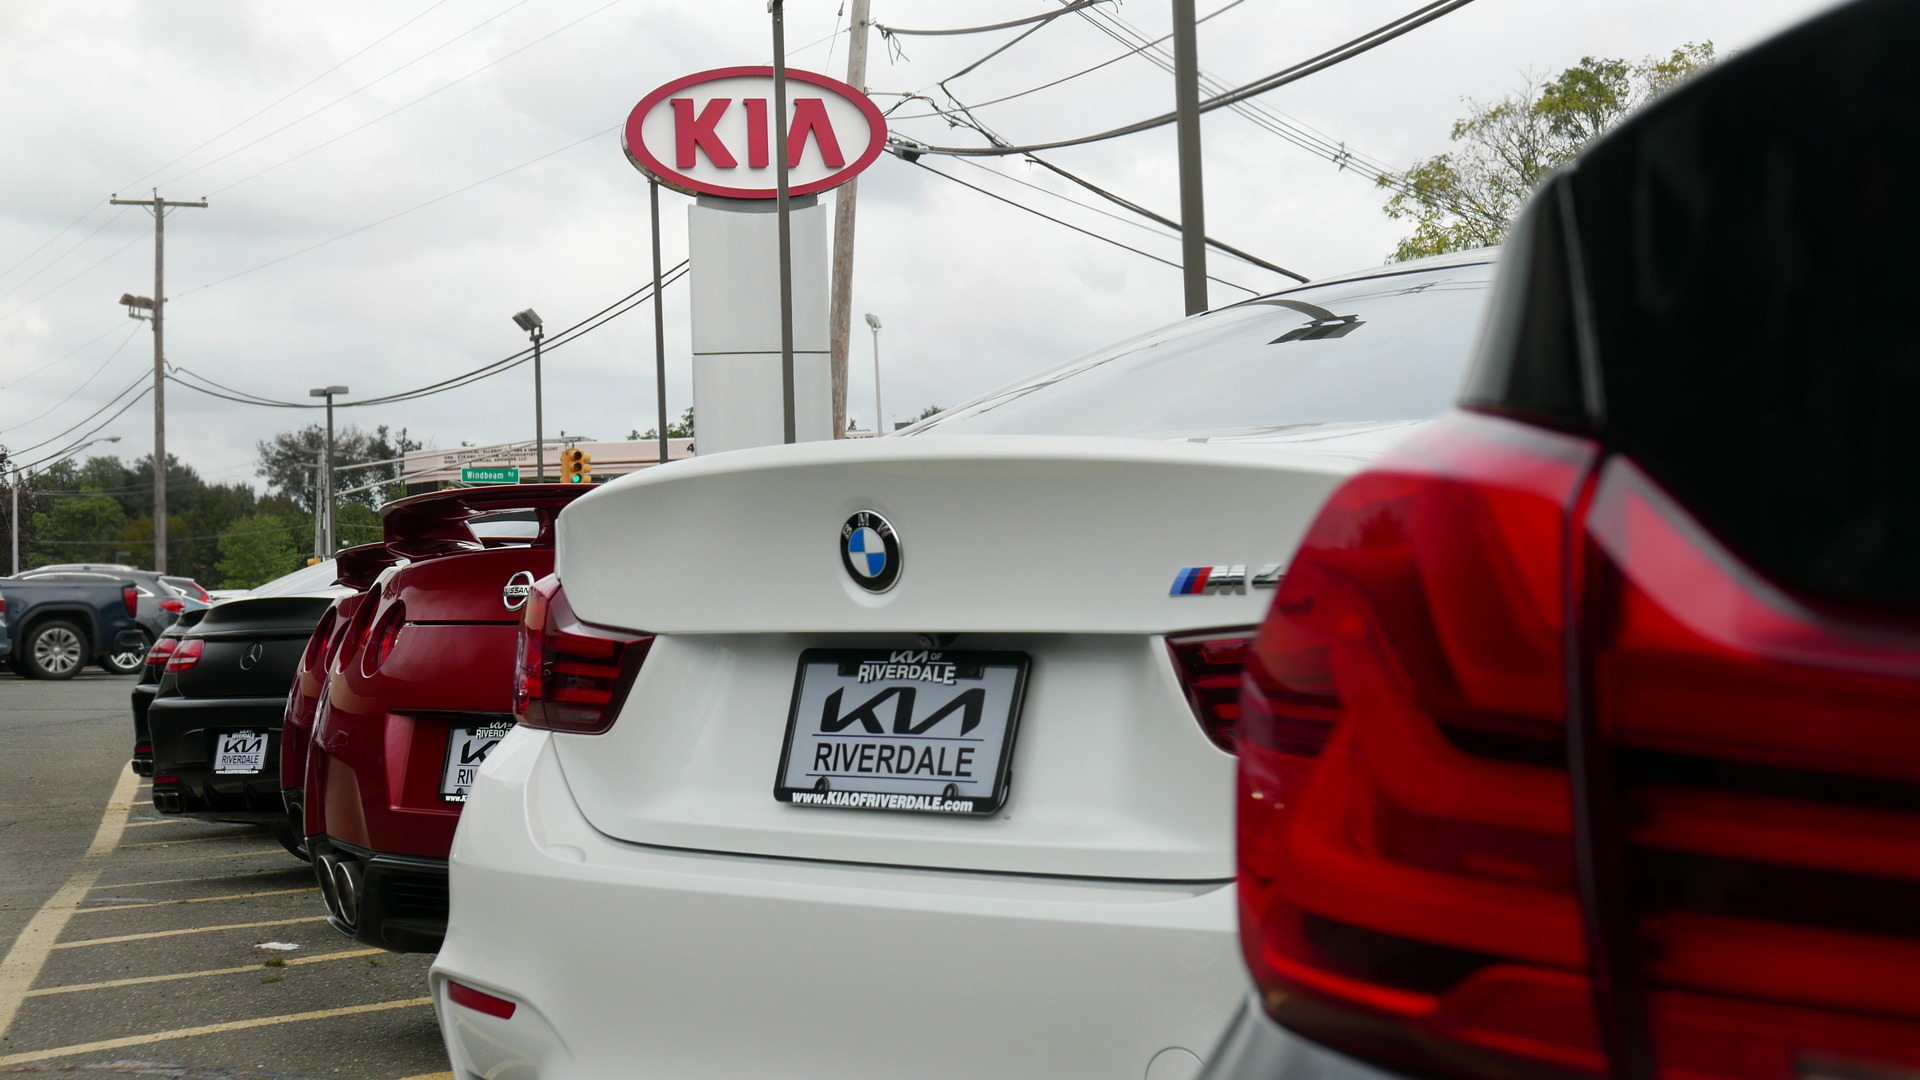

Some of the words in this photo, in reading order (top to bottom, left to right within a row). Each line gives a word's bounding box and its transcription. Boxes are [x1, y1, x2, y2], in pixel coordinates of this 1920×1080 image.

[669, 98, 846, 168] KIA
[466, 471, 504, 480] Windbeam
[841, 512, 892, 540] BMW
[889, 650, 928, 664] KIA
[930, 652, 943, 661] OF
[857, 664, 957, 685] RIVERDALE
[820, 686, 986, 737] KIA
[475, 729, 509, 740] RIVERD
[223, 738, 262, 753] KIA
[221, 755, 259, 764] RIVERDALE
[813, 742, 975, 777] RIVERDALE
[791, 791, 974, 813] www.KIAOFRIVERDALE.com
